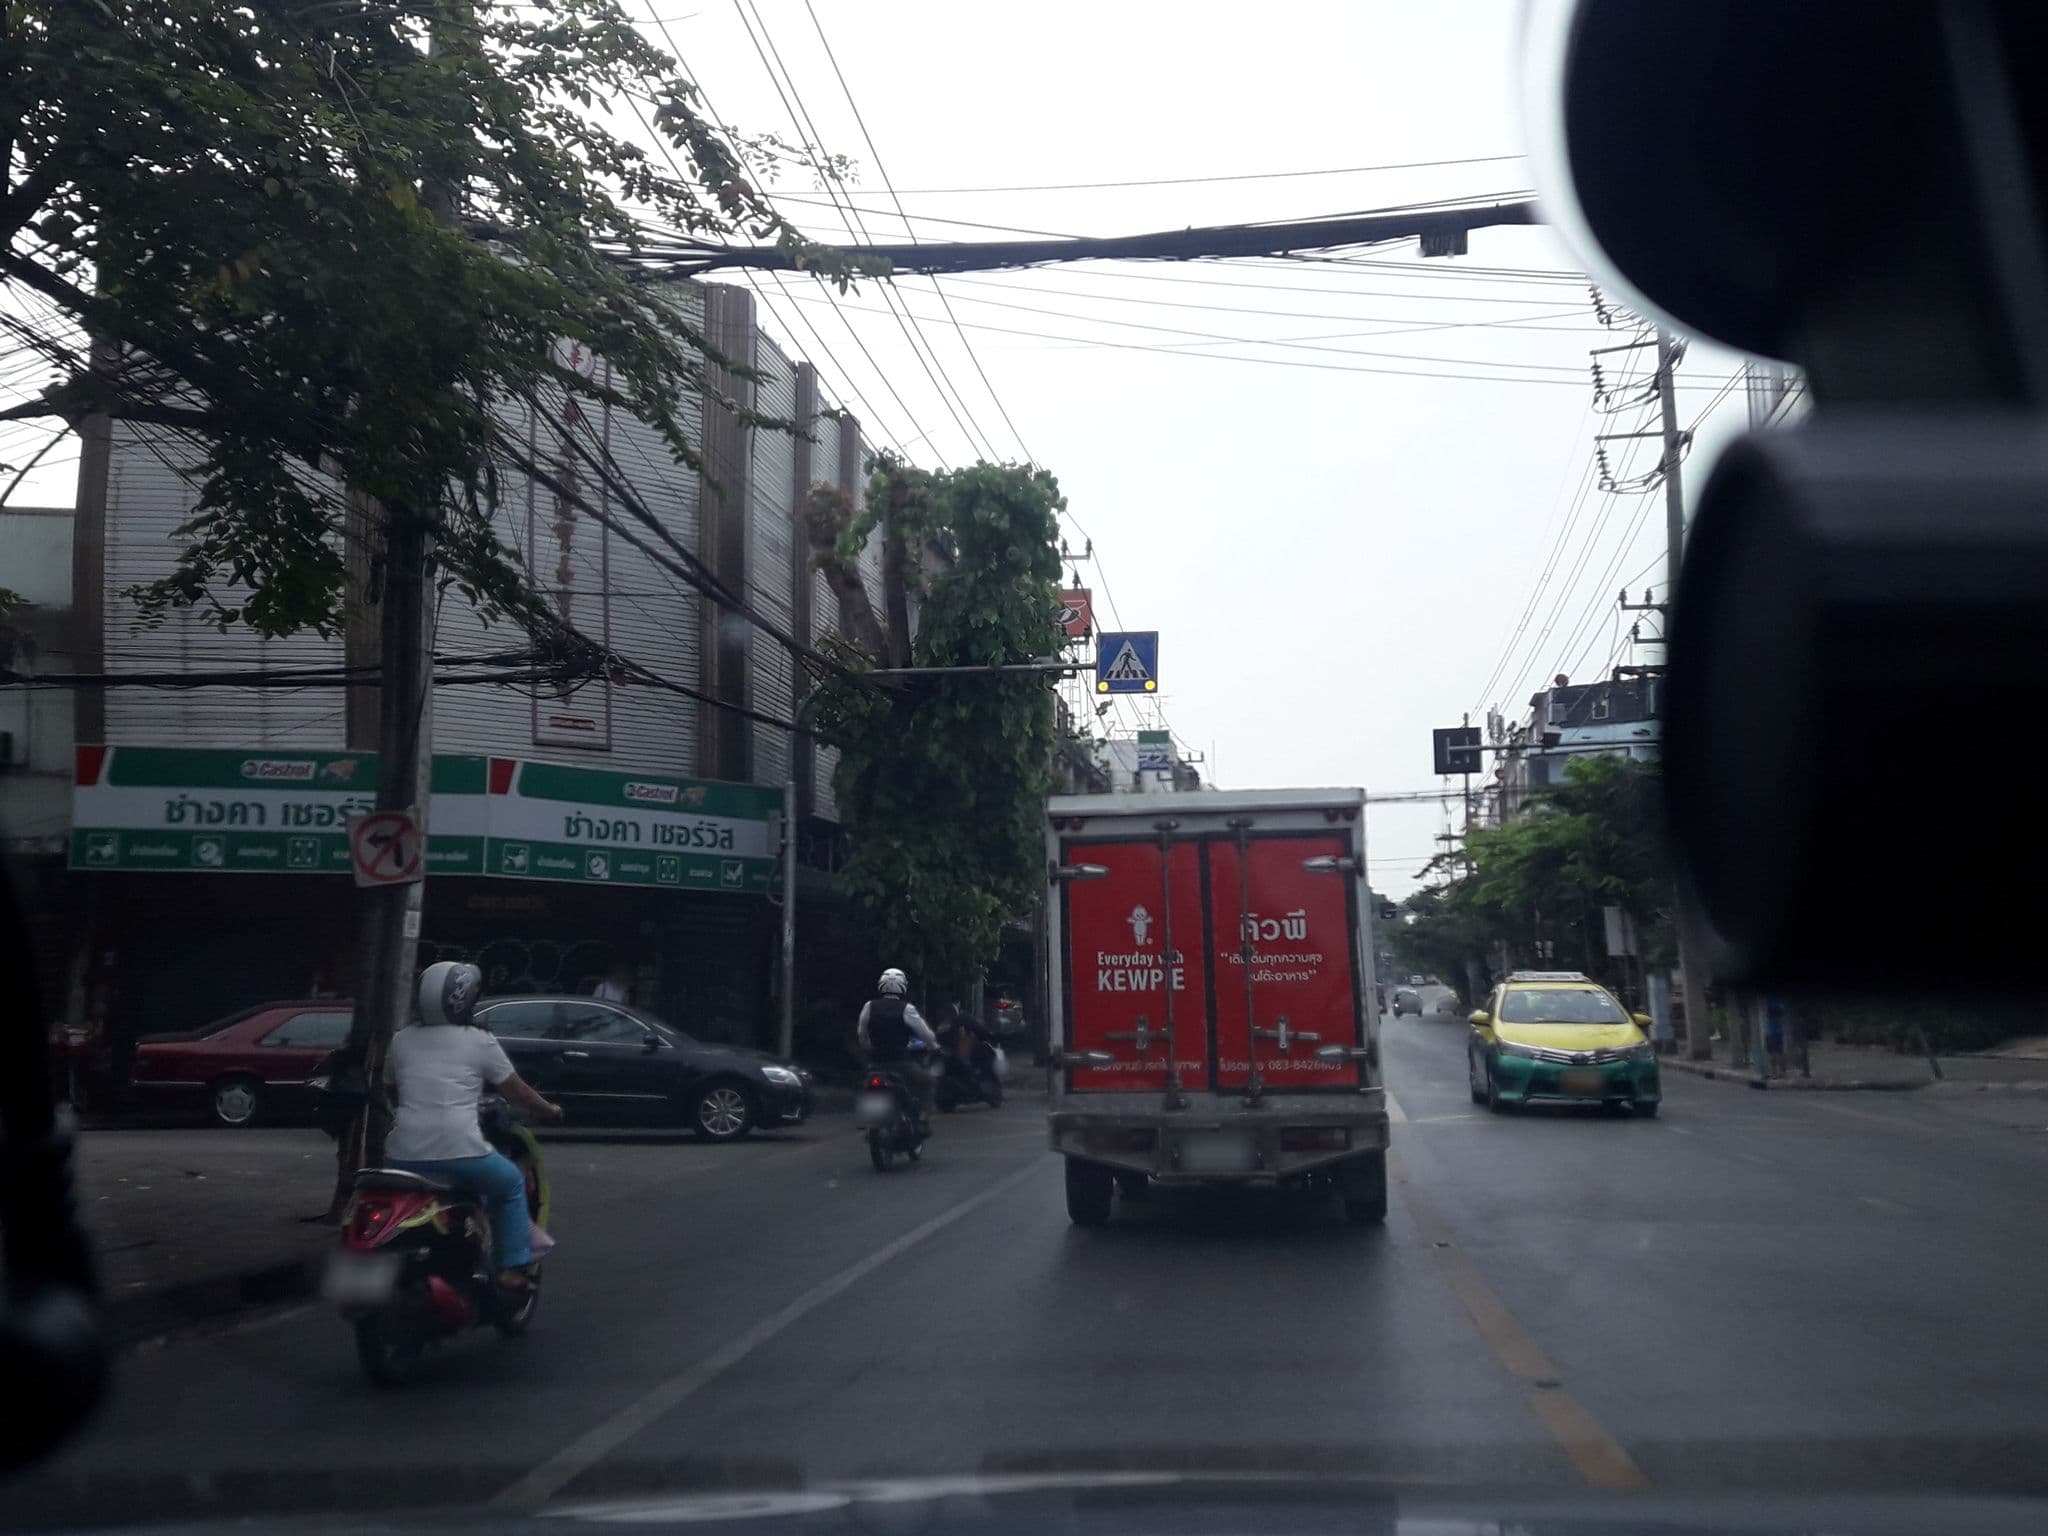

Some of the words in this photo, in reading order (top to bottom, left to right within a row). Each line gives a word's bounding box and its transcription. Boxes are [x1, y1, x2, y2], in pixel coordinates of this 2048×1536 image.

[259, 762, 313, 778] Castrol
[636, 785, 676, 802] Castrol
[1097, 951, 1154, 968] Everyday
[1097, 968, 1185, 992] KEWPE
